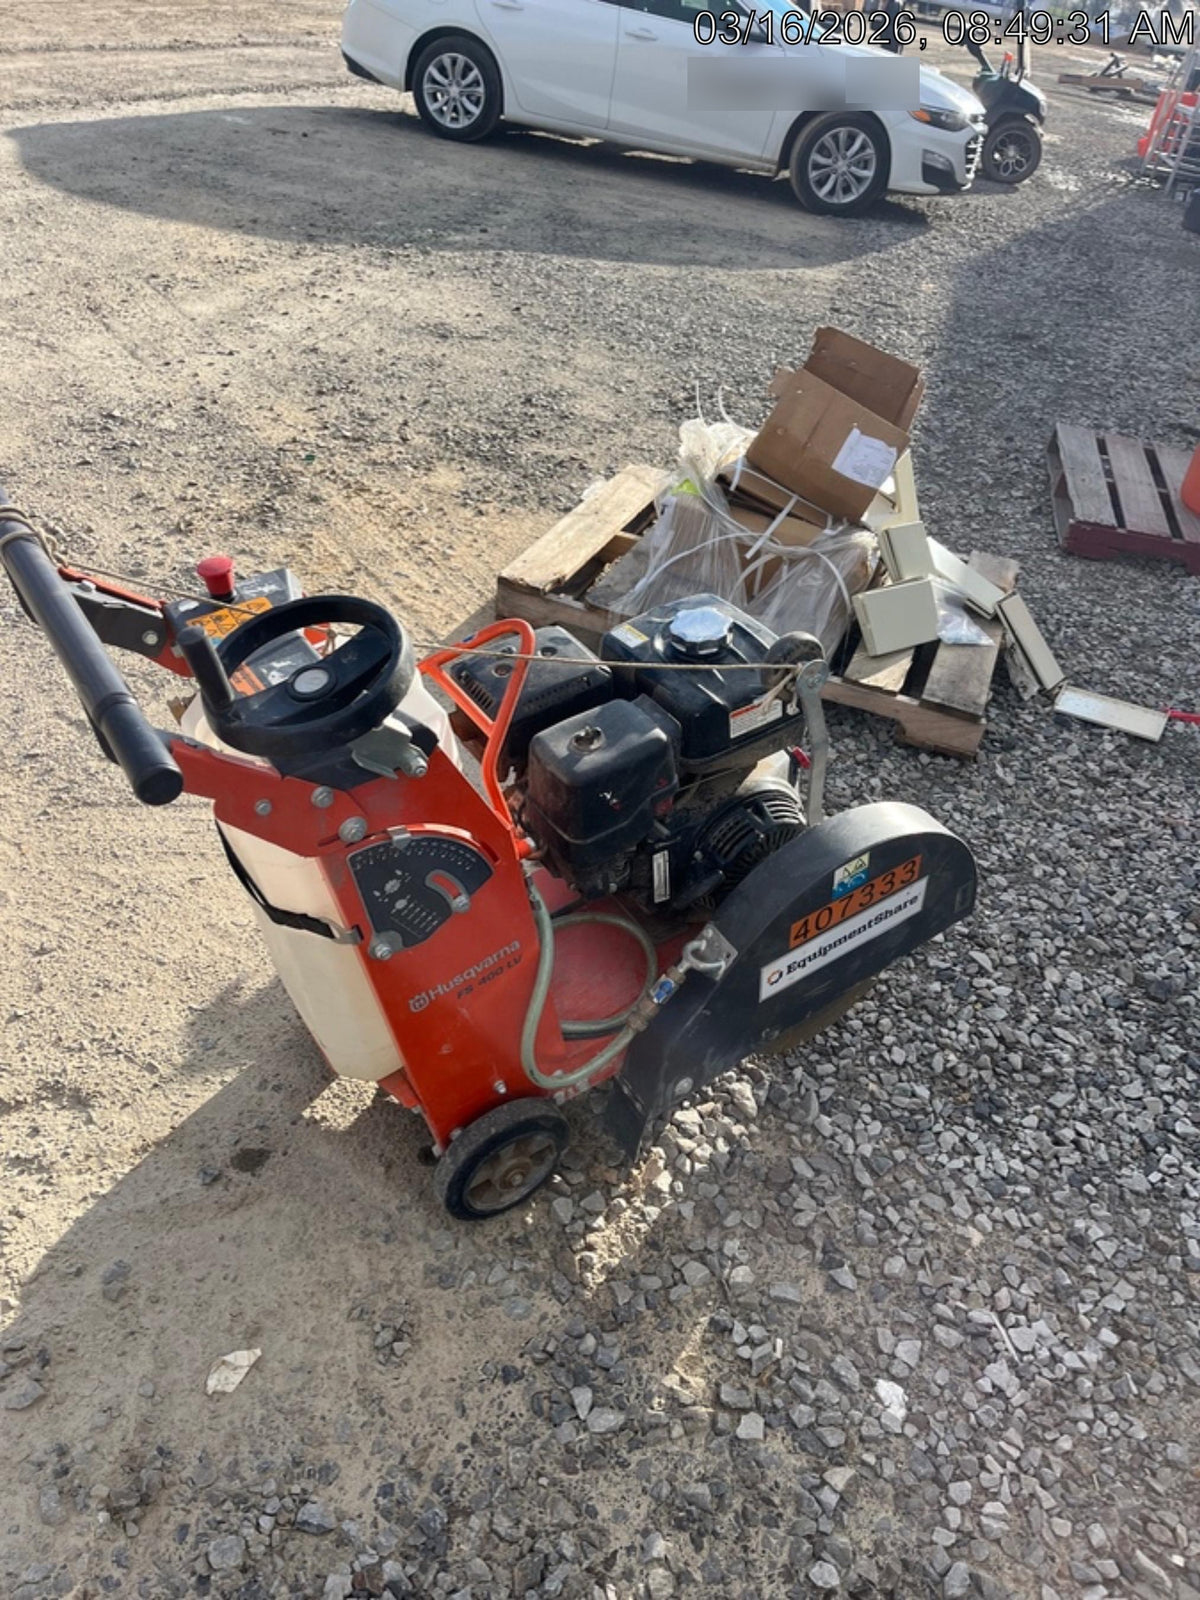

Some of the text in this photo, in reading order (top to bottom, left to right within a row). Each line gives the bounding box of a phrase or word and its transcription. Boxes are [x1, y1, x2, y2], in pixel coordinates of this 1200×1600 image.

[786, 894, 919, 975] EquipmentShare
[793, 859, 917, 942] 407333
[428, 940, 521, 1001] Husqvarna
[457, 984, 474, 1000] FS
[478, 966, 504, 986] 400
